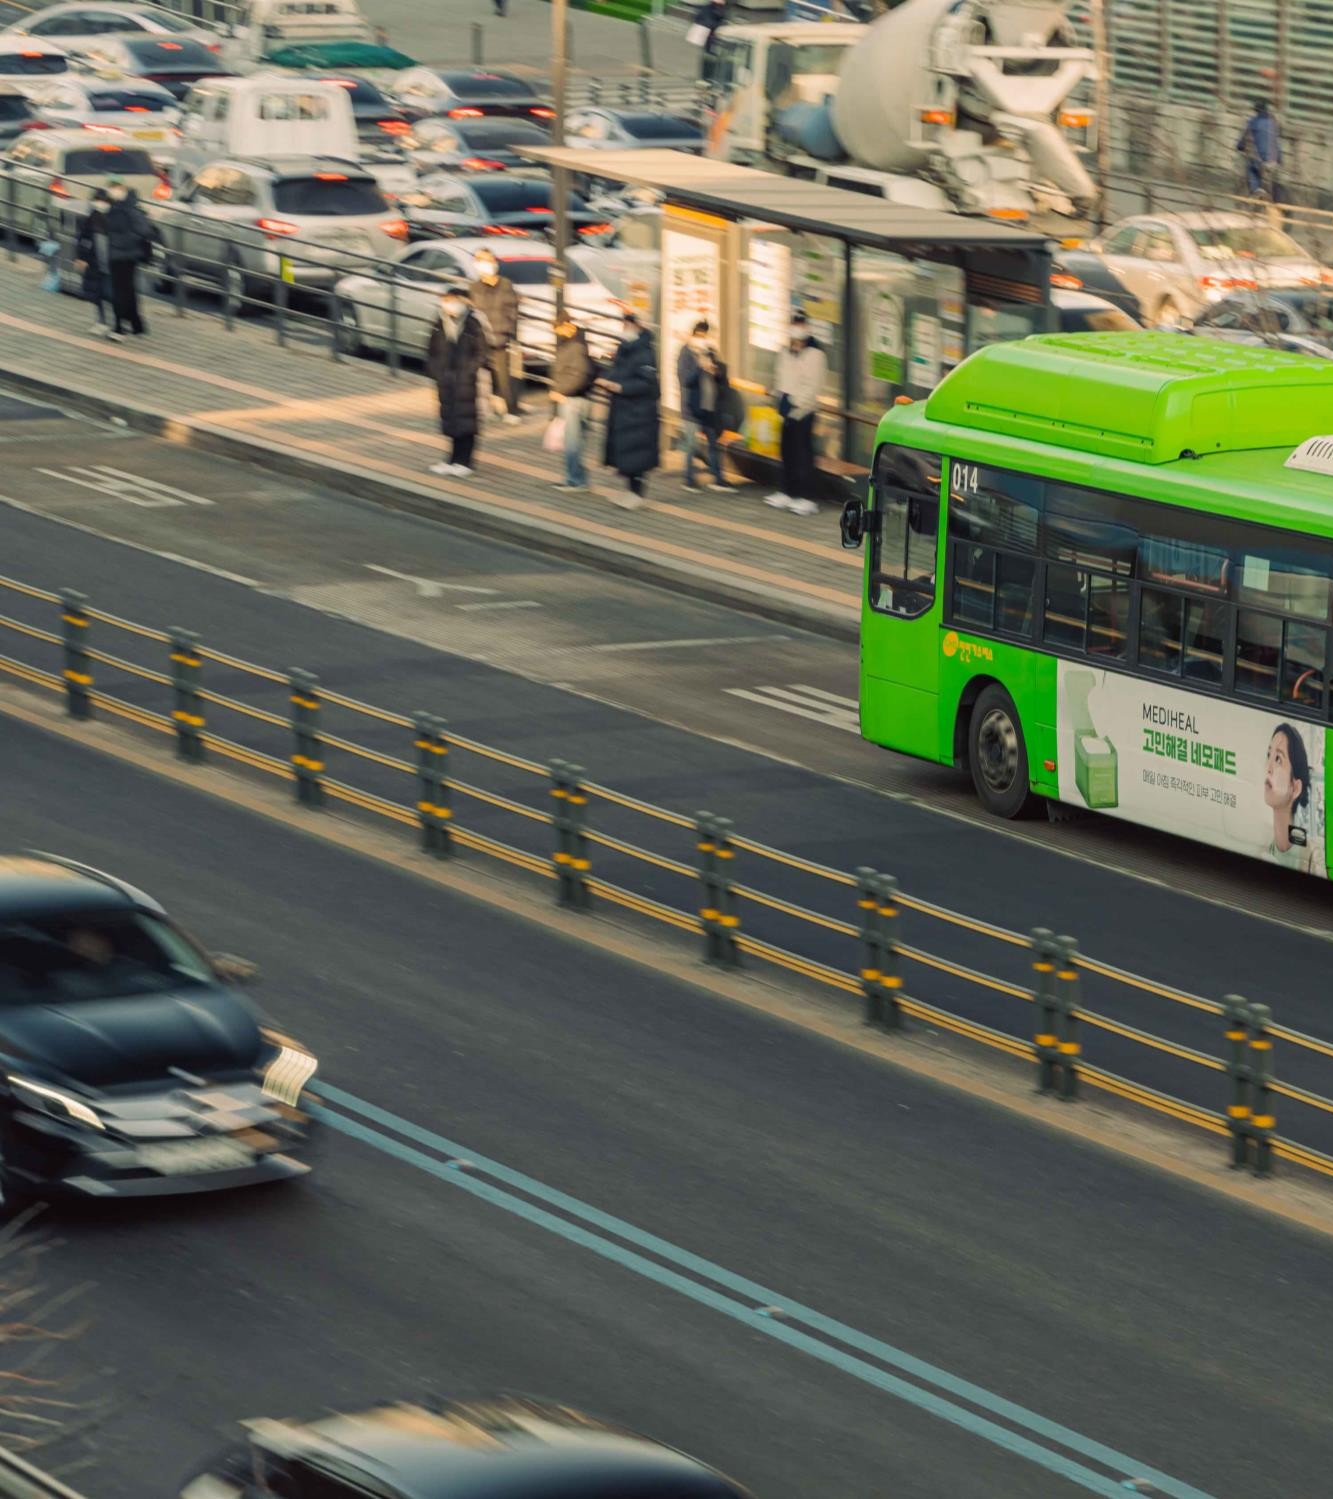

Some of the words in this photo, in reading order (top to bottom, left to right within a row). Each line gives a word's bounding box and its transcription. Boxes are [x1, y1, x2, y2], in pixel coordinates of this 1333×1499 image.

[952, 462, 979, 494] 014
[1142, 703, 1200, 735] MEDIHEAL
[1142, 728, 1188, 763] 고민해결
[1190, 740, 1237, 775] 네모패드
